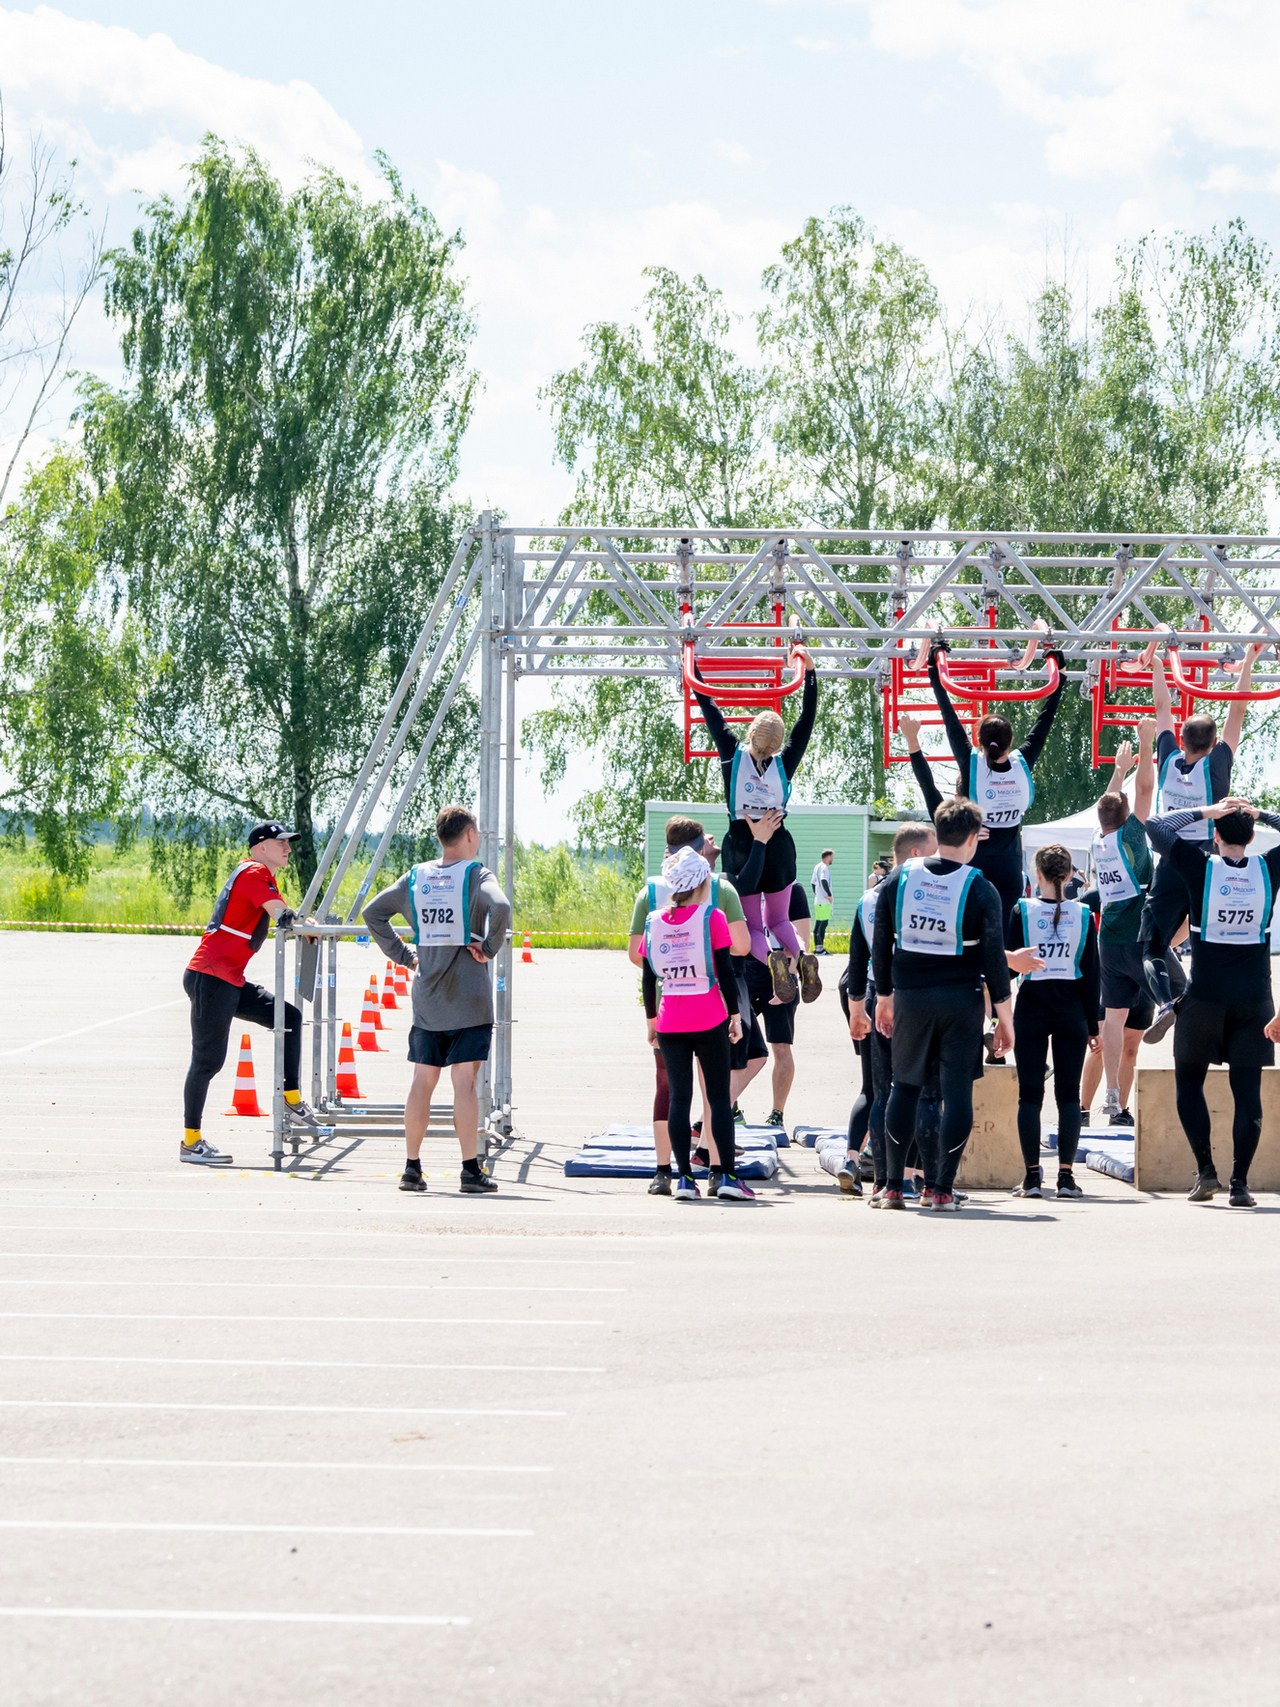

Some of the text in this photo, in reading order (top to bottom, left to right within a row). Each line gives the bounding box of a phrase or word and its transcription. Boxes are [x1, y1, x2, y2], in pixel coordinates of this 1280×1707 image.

[986, 809, 1020, 823] 5770
[1099, 870, 1122, 885] 5045
[421, 908, 454, 924] 5782
[909, 914, 946, 932] 5773
[1217, 910, 1254, 925] 5775
[1038, 943, 1070, 958] 5772
